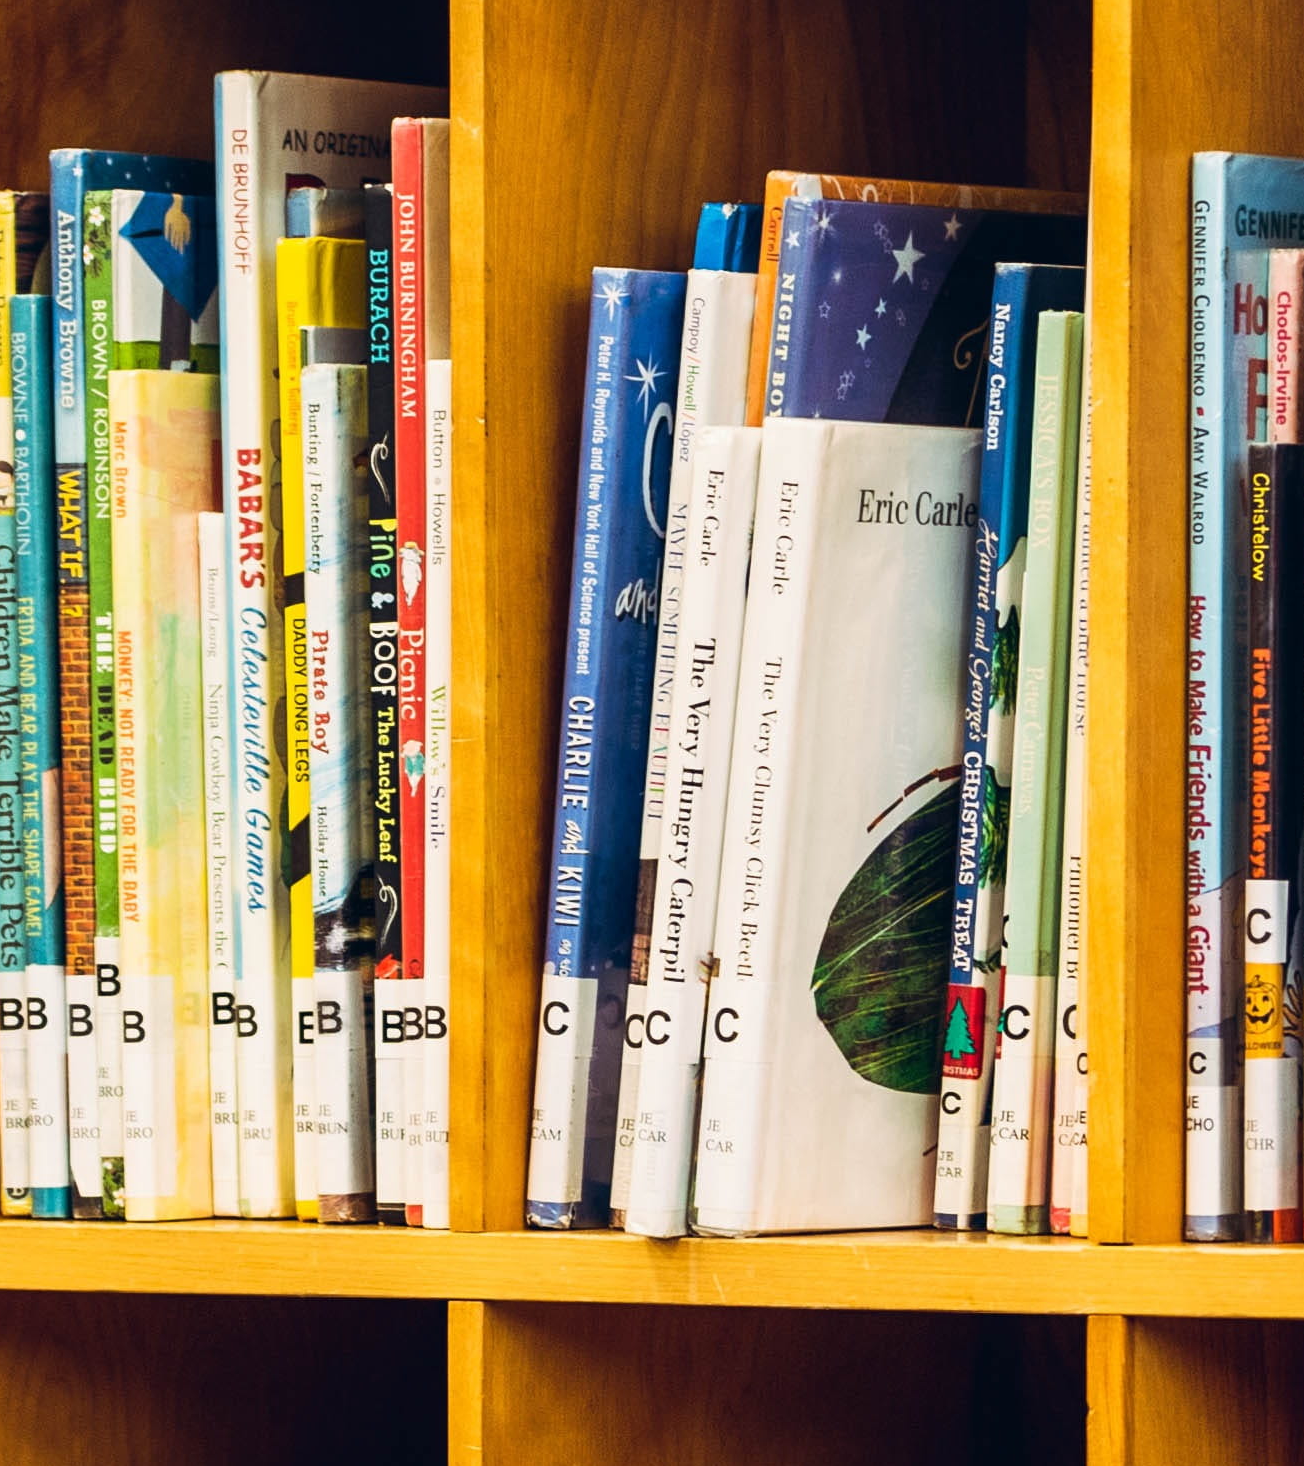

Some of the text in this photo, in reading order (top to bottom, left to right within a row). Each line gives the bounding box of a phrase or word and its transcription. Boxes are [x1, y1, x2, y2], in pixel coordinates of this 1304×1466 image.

[232, 128, 253, 276] DE BRUNHOFF
[369, 249, 391, 364] BURACH
[986, 302, 1011, 451] Nancy Carlson
[396, 192, 425, 722] JOHN BURNINGHAM Picnic
[857, 488, 979, 528] Eric Carle
[1252, 472, 1271, 583] Christelow
[236, 448, 272, 916] BABAR'S Celesteville Games
[310, 629, 330, 756] Pirate Boy
[689, 638, 716, 688] The
[679, 698, 711, 758] Very
[1250, 648, 1272, 879] Five Little Monkeys
[554, 695, 595, 927] CHARLIE and KIWI
[668, 767, 704, 870] Hungry
[952, 749, 984, 974] CHRISTMAS TREAT
[1246, 908, 1272, 945] C
[317, 999, 342, 1035] B
[714, 1007, 740, 1043] C
[705, 1138, 734, 1155] CAR
